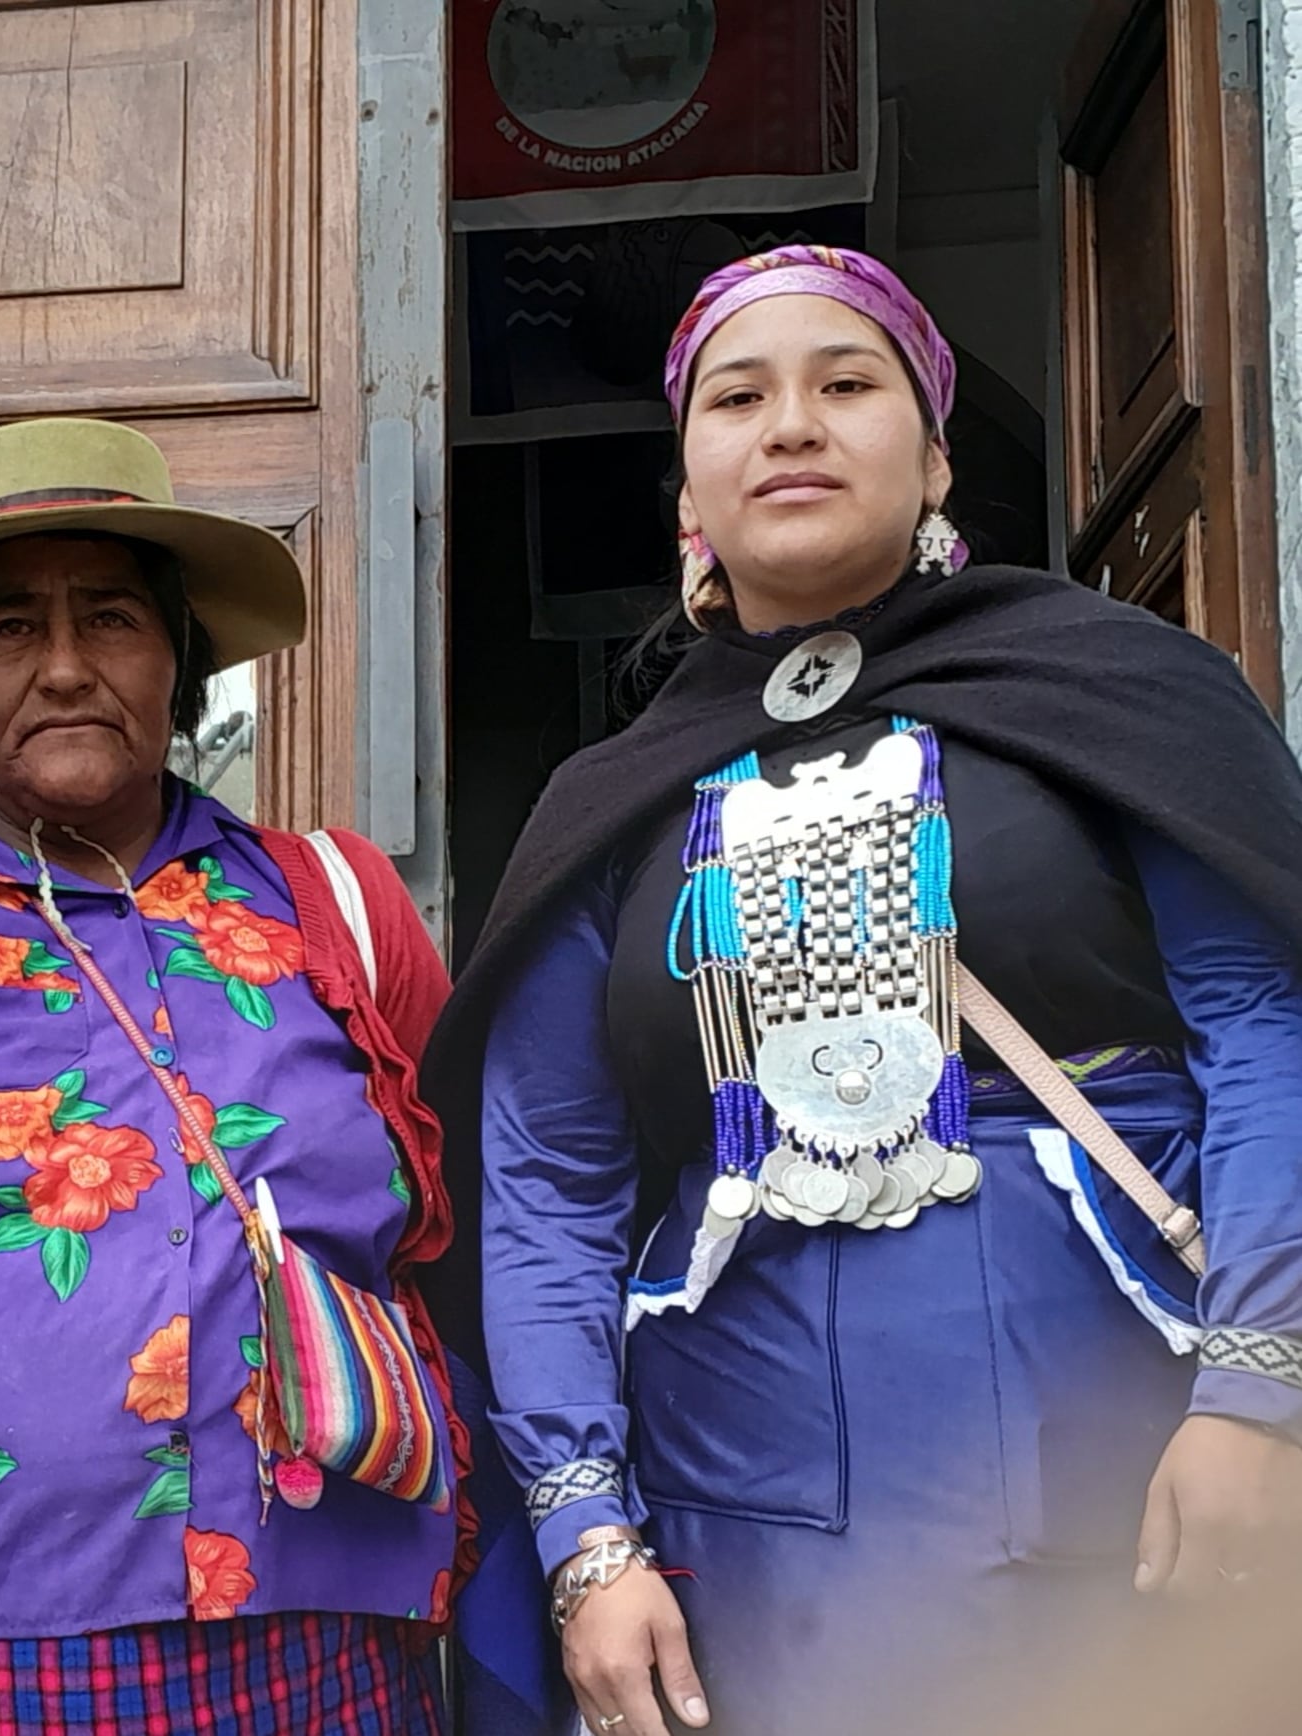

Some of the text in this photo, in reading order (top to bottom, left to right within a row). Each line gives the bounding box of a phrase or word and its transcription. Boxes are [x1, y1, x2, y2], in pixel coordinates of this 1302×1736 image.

[495, 101, 711, 172] DE LA NACION ATACAMA
